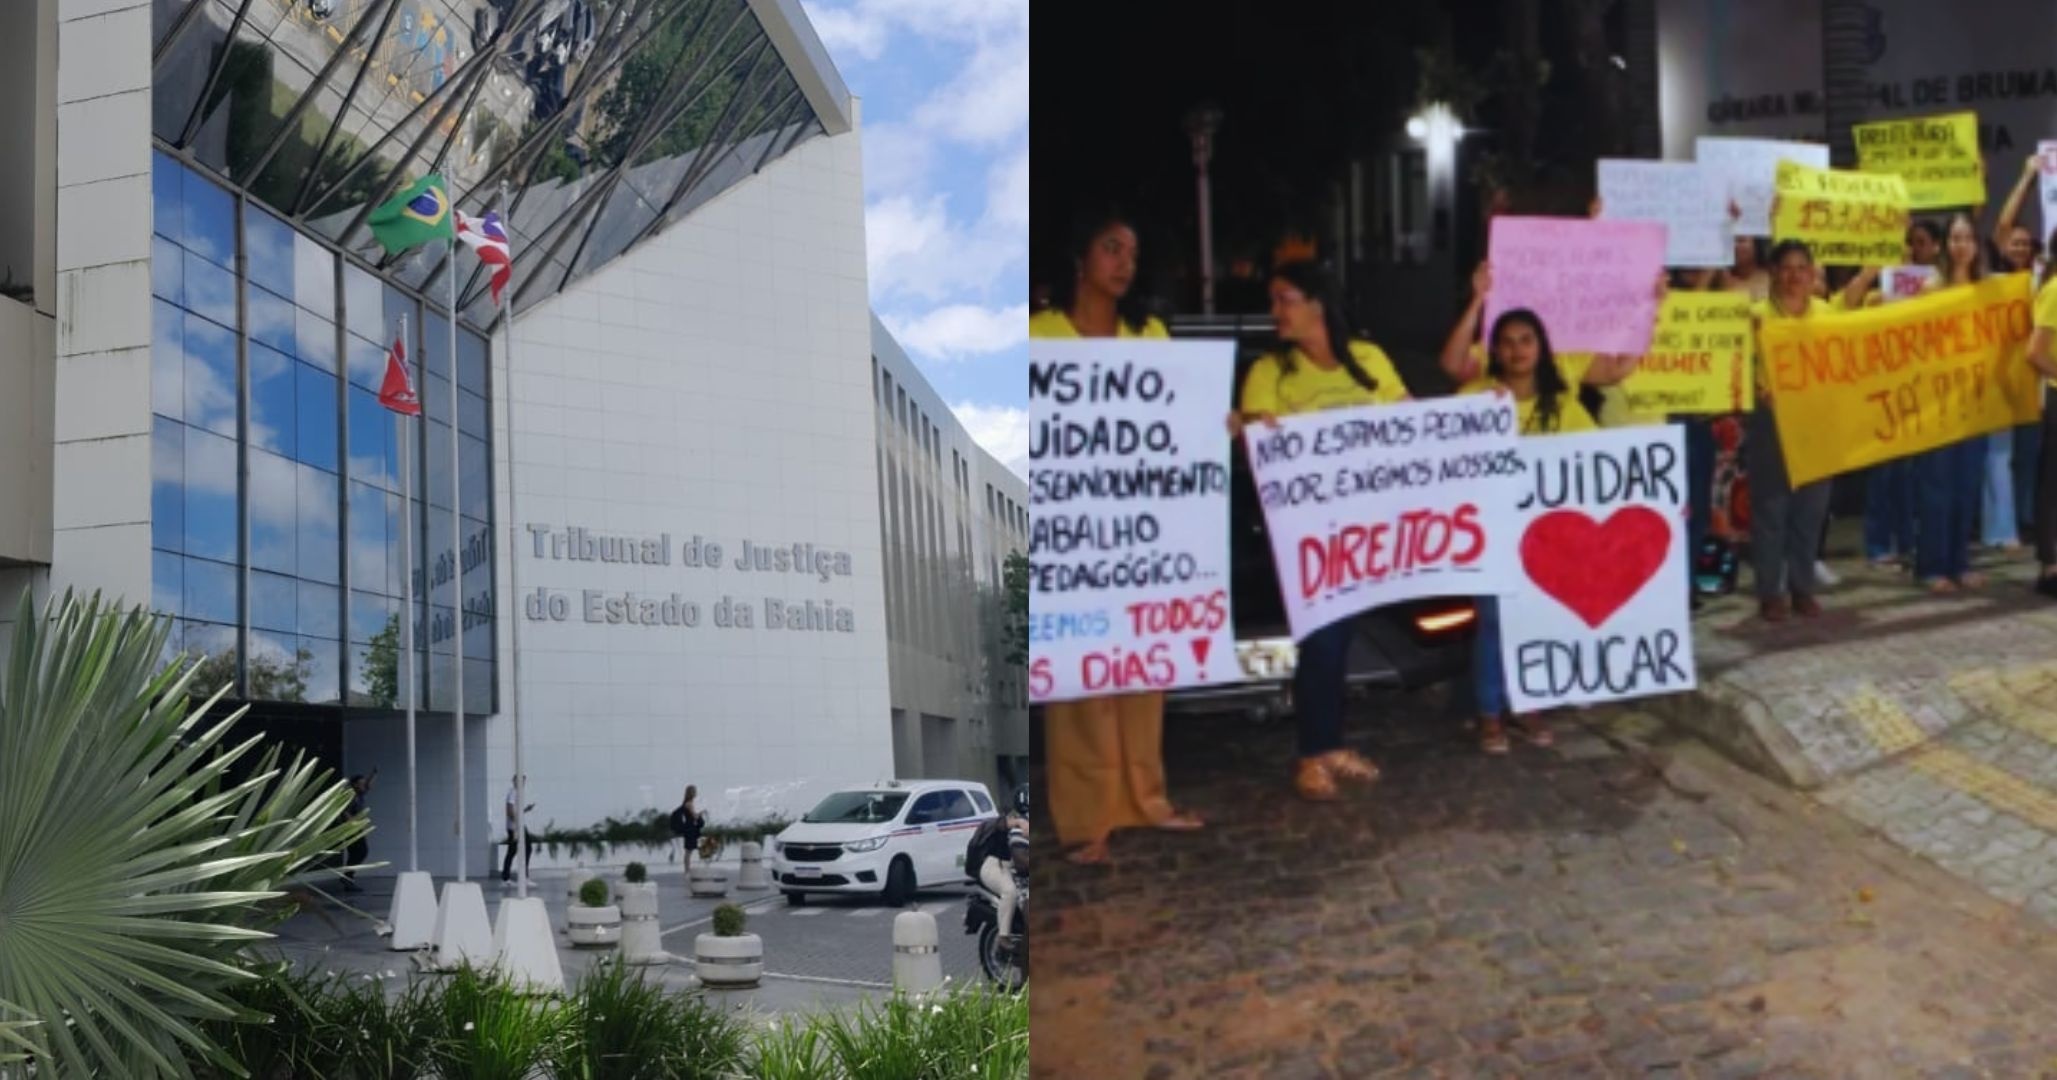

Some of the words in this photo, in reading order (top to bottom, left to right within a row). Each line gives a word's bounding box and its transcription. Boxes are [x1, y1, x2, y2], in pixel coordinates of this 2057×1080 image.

[1772, 299, 2033, 391] ENQUADRAMENTO
[1256, 426, 1304, 468] NÃO
[1313, 415, 1418, 457] ESTAMOS
[1439, 448, 1519, 482] NOSSOS
[526, 523, 671, 566] Tribunal
[683, 536, 723, 568] de
[735, 540, 853, 583] Justiça
[525, 586, 570, 621] do
[582, 589, 700, 628] Estado
[714, 595, 755, 629] da
[765, 597, 855, 634] Bahia
[1126, 590, 1227, 637] TODOS
[1517, 629, 1688, 697] EDUCAR
